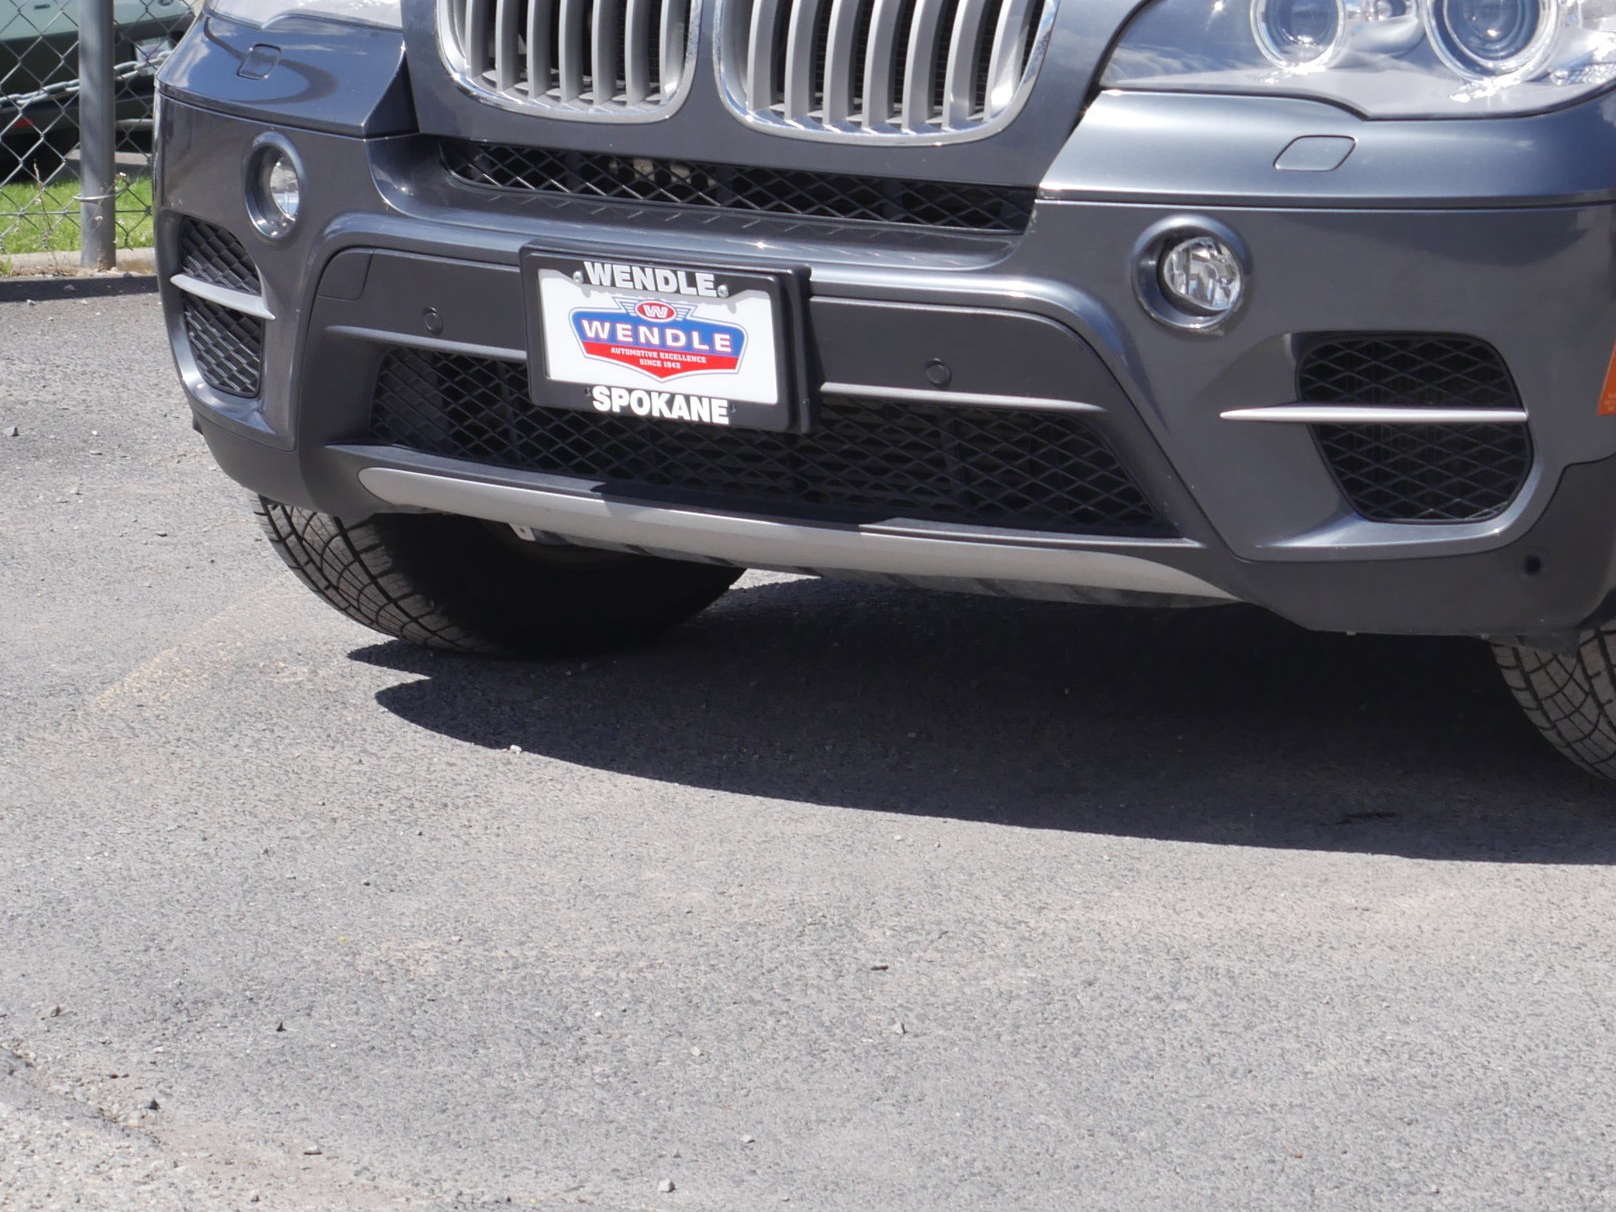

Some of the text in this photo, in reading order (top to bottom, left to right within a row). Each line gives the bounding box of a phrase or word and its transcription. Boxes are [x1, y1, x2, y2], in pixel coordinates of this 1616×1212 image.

[583, 261, 718, 297] WENDLE
[581, 319, 732, 353] WENDLE
[610, 347, 707, 364] AUTOMOTIVE EXCELLENCE
[639, 358, 682, 369] SINCE 1943
[592, 385, 730, 425] SPOKANE
